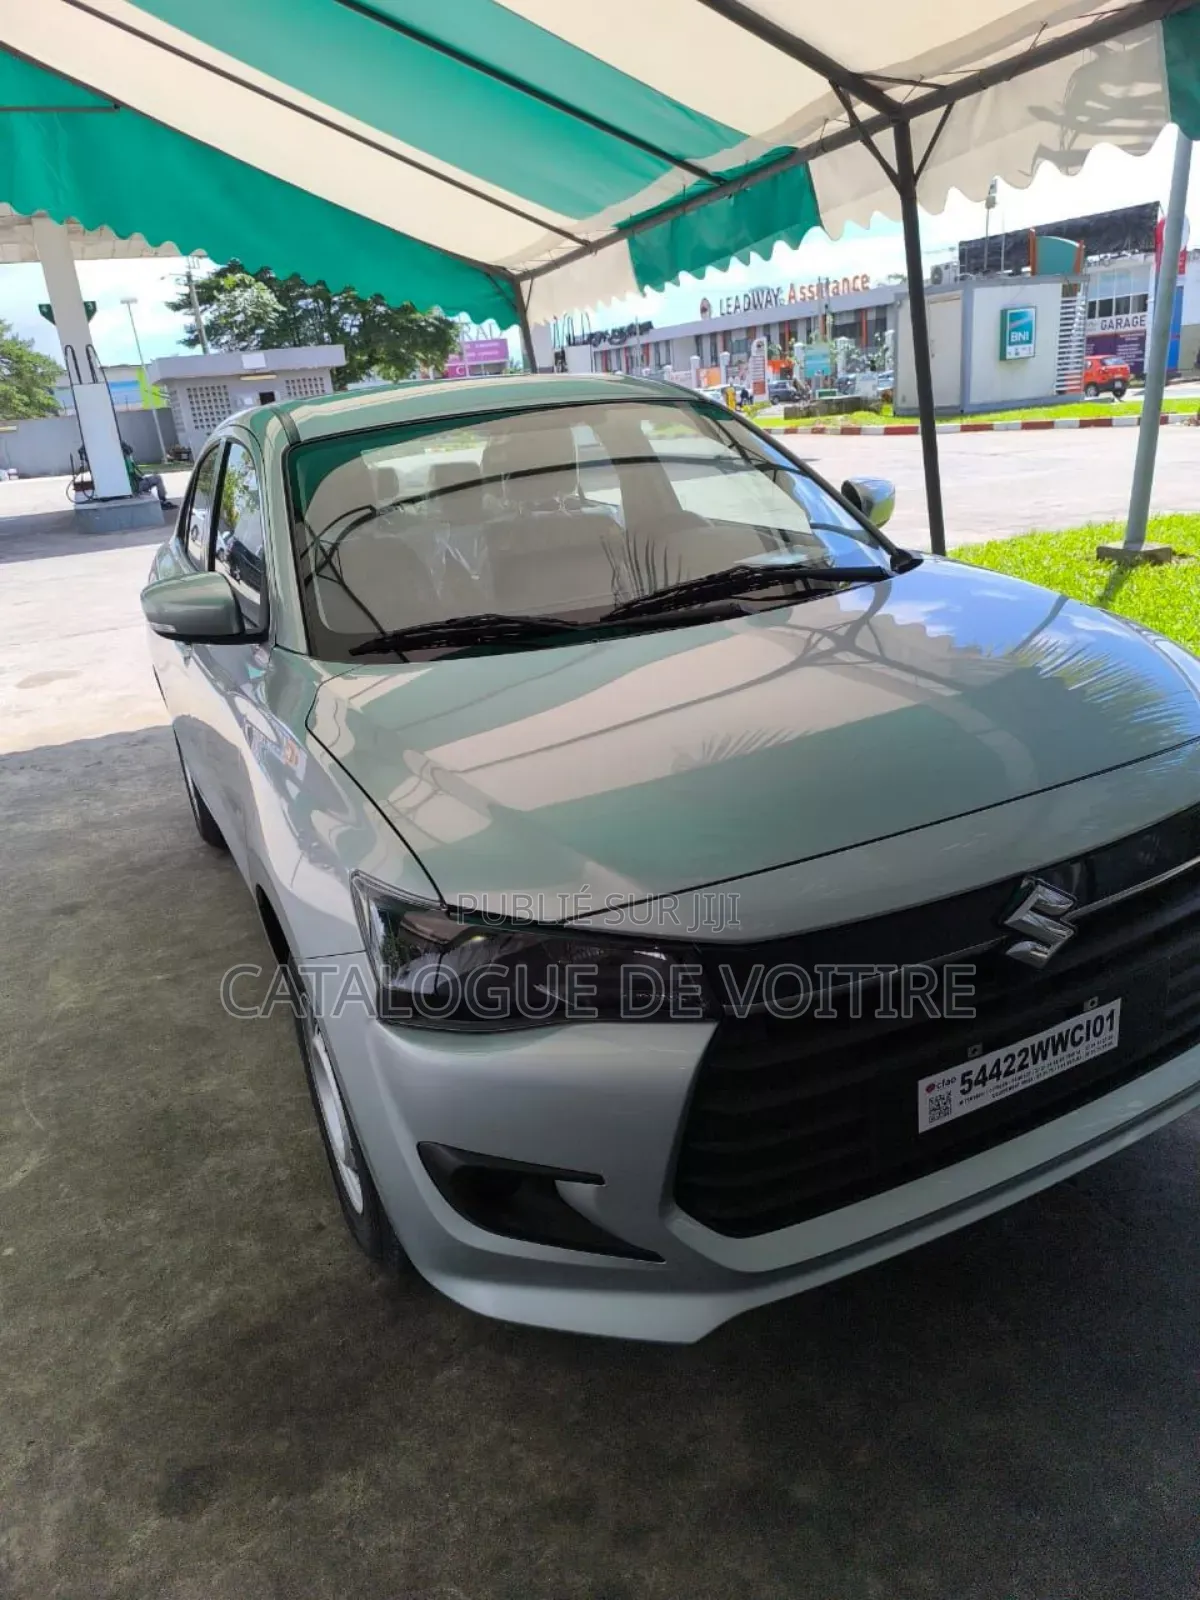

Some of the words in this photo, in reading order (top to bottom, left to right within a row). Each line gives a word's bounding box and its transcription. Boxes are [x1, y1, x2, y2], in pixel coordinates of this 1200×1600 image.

[719, 286, 781, 316] LEADWAY
[1100, 314, 1146, 331] GARAGE
[1010, 330, 1030, 342] BNI
[959, 1009, 1115, 1095] 54422WWCI01
